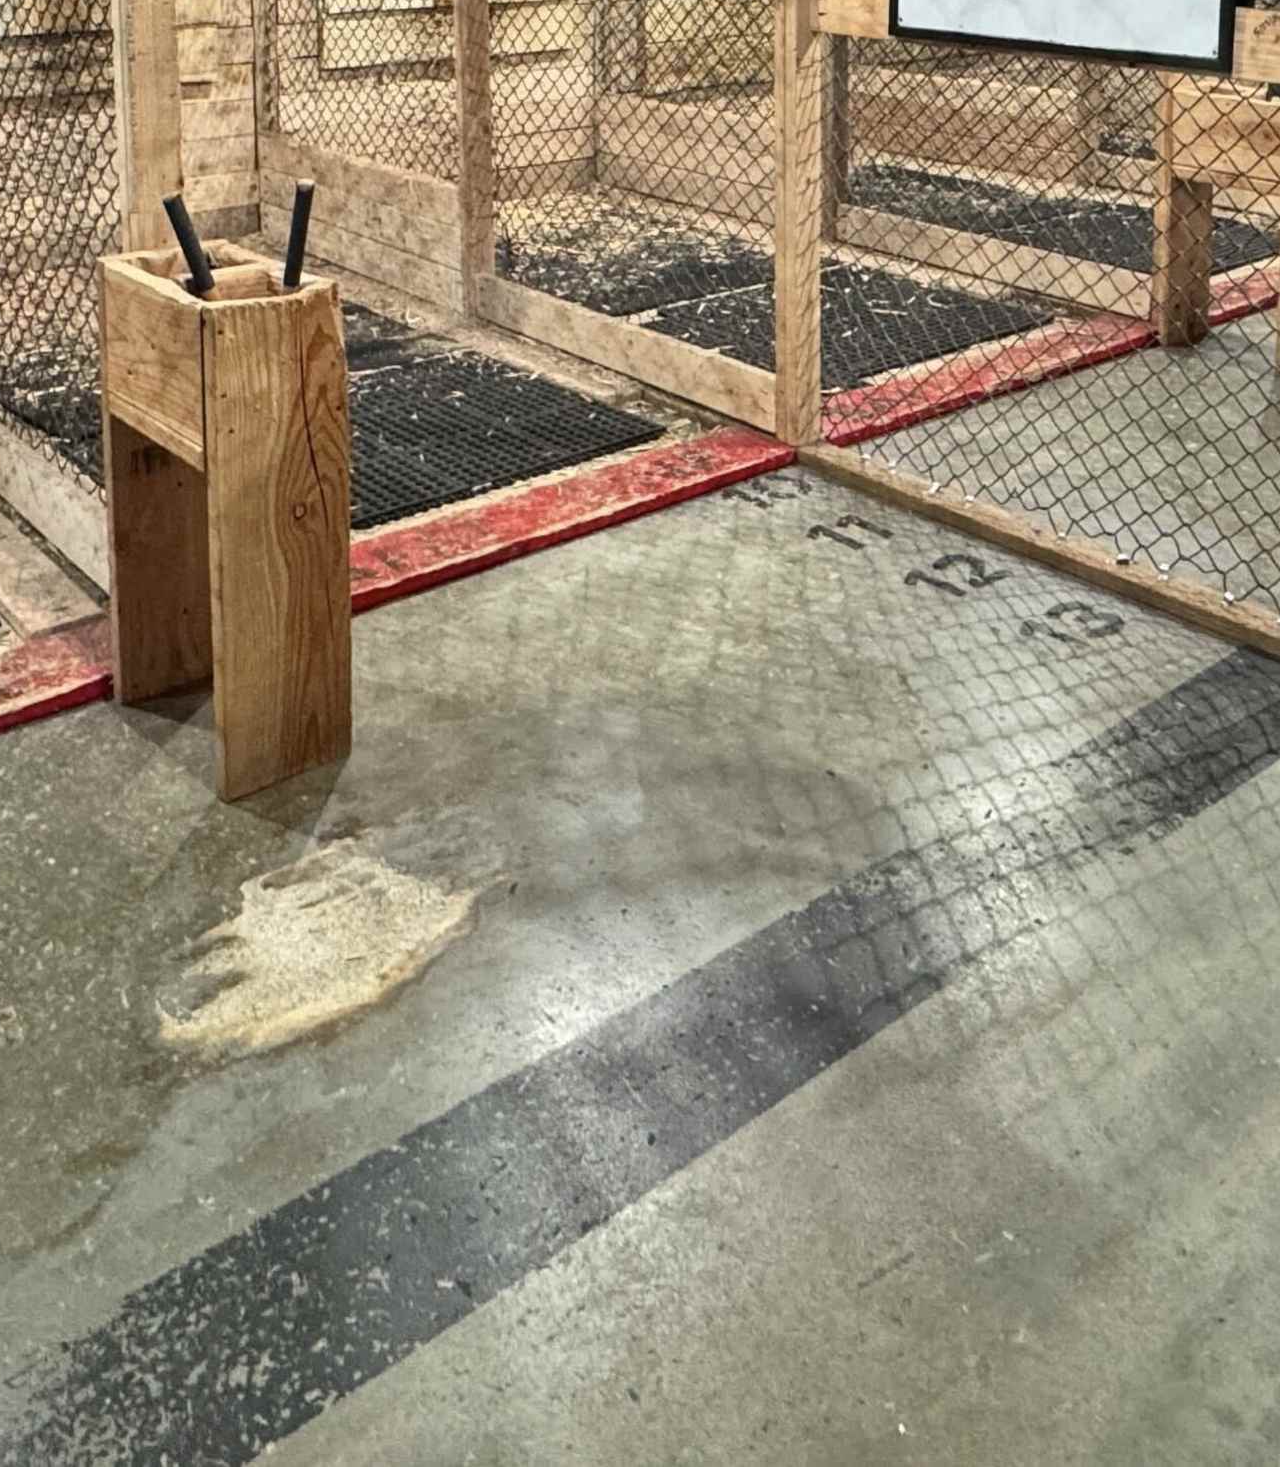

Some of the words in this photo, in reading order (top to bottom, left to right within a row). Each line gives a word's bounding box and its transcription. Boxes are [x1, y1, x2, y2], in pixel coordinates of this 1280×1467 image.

[807, 515, 894, 551] 11
[903, 553, 1011, 597] 12
[1019, 600, 1125, 646] 13
